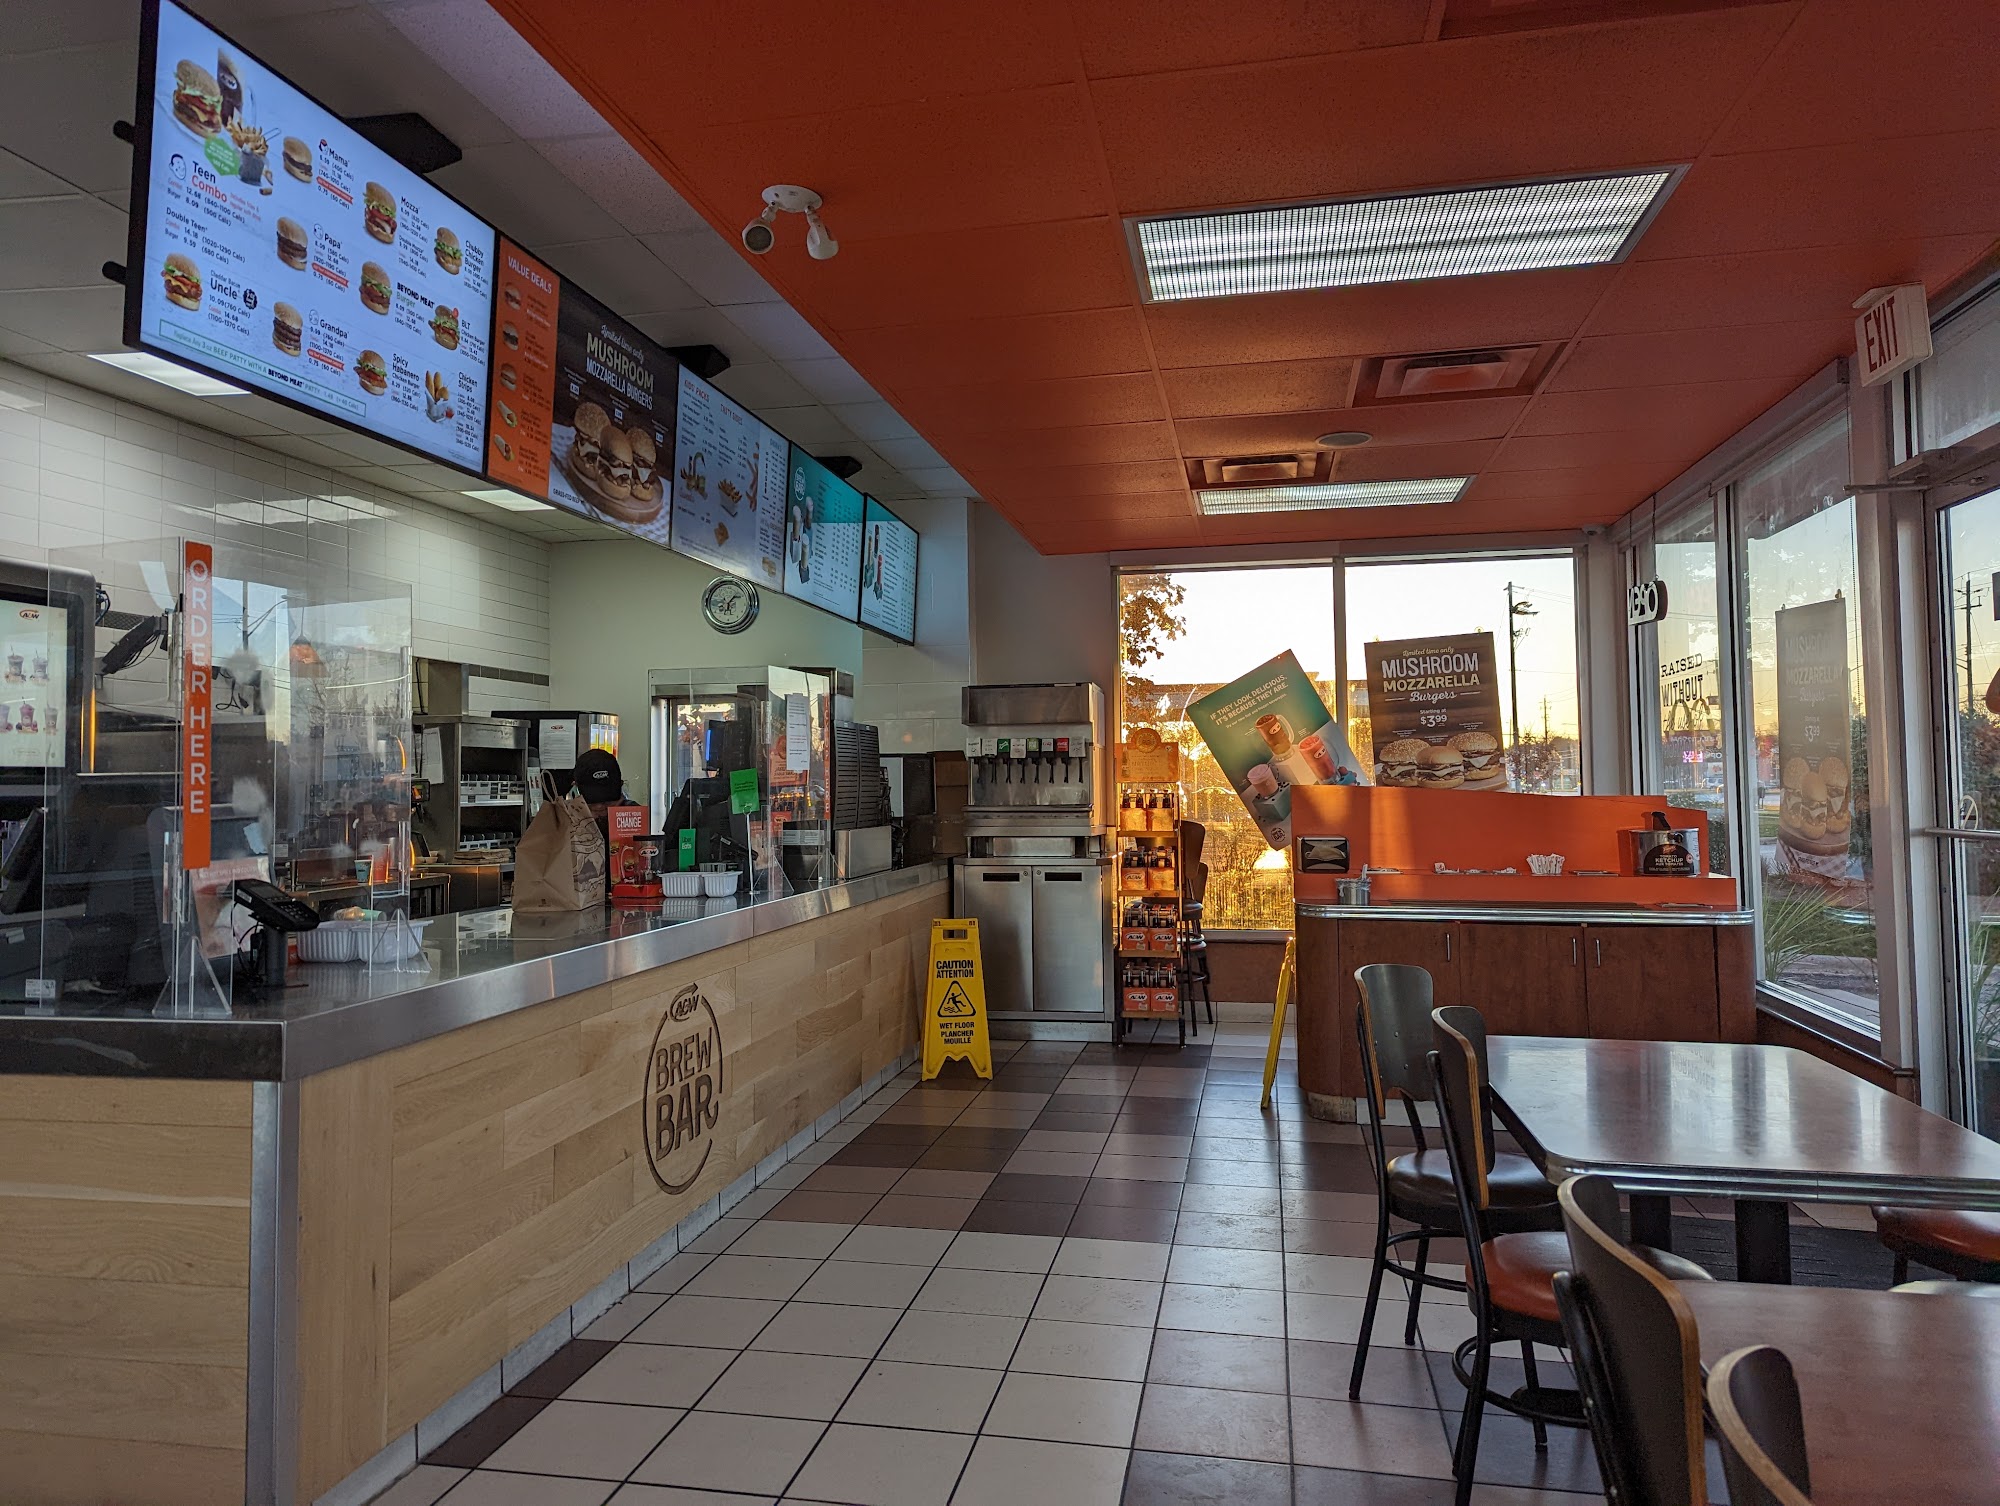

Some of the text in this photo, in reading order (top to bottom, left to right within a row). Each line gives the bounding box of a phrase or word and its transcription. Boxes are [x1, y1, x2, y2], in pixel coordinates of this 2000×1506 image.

[328, 147, 349, 168] Mama
[192, 160, 216, 184] Teen
[192, 175, 227, 203] Combo
[401, 196, 419, 215] Mozza
[166, 206, 191, 226] Double
[324, 233, 341, 250] Papa
[465, 240, 484, 259] Chubby
[464, 256, 482, 274] Burger
[465, 249, 484, 267] Chicken
[508, 255, 552, 295] VALUE DEALS
[210, 277, 238, 300] Uncle
[397, 282, 436, 311] BEYOND MEAT
[396, 293, 416, 310] Burger
[320, 319, 348, 340] Grandpa
[461, 319, 471, 331] BLT
[1864, 296, 1898, 374] EXIT
[213, 345, 229, 360] BEEF
[229, 351, 247, 366] PATTY
[268, 368, 289, 384] BEYOND
[392, 353, 409, 369] Spicy
[587, 332, 654, 393] MUSHROOM
[392, 362, 420, 382] Habanero
[458, 371, 478, 389] Chicken
[458, 380, 473, 393] Strips
[586, 357, 626, 394] MOZZARELLA
[626, 382, 653, 411] BURGERS
[1403, 646, 1454, 657] Limited time only
[1381, 652, 1479, 679] MUSHROOM
[1661, 653, 1703, 677] RAISED
[189, 559, 209, 815] ORDER HERE
[1383, 673, 1480, 693] MOZZARELLA
[1661, 674, 1703, 707] WITHOUT
[1209, 674, 1288, 721] IF THEY LOOK DELICIOUS.
[1215, 682, 1289, 727] IT'S BECAUSE THEY ARE.
[1409, 691, 1457, 704] Burgers
[616, 817, 642, 828] CHANGE
[640, 848, 658, 856] A&W
[936, 960, 974, 970] CAUTION
[936, 969, 974, 979] ATTENTION
[940, 1030, 974, 1038] PLANCHER
[954, 1021, 975, 1029] FLOOR
[944, 1037, 971, 1045] MOUILLÉ
[655, 1026, 713, 1095] BREW
[655, 1072, 719, 1163] BAR
